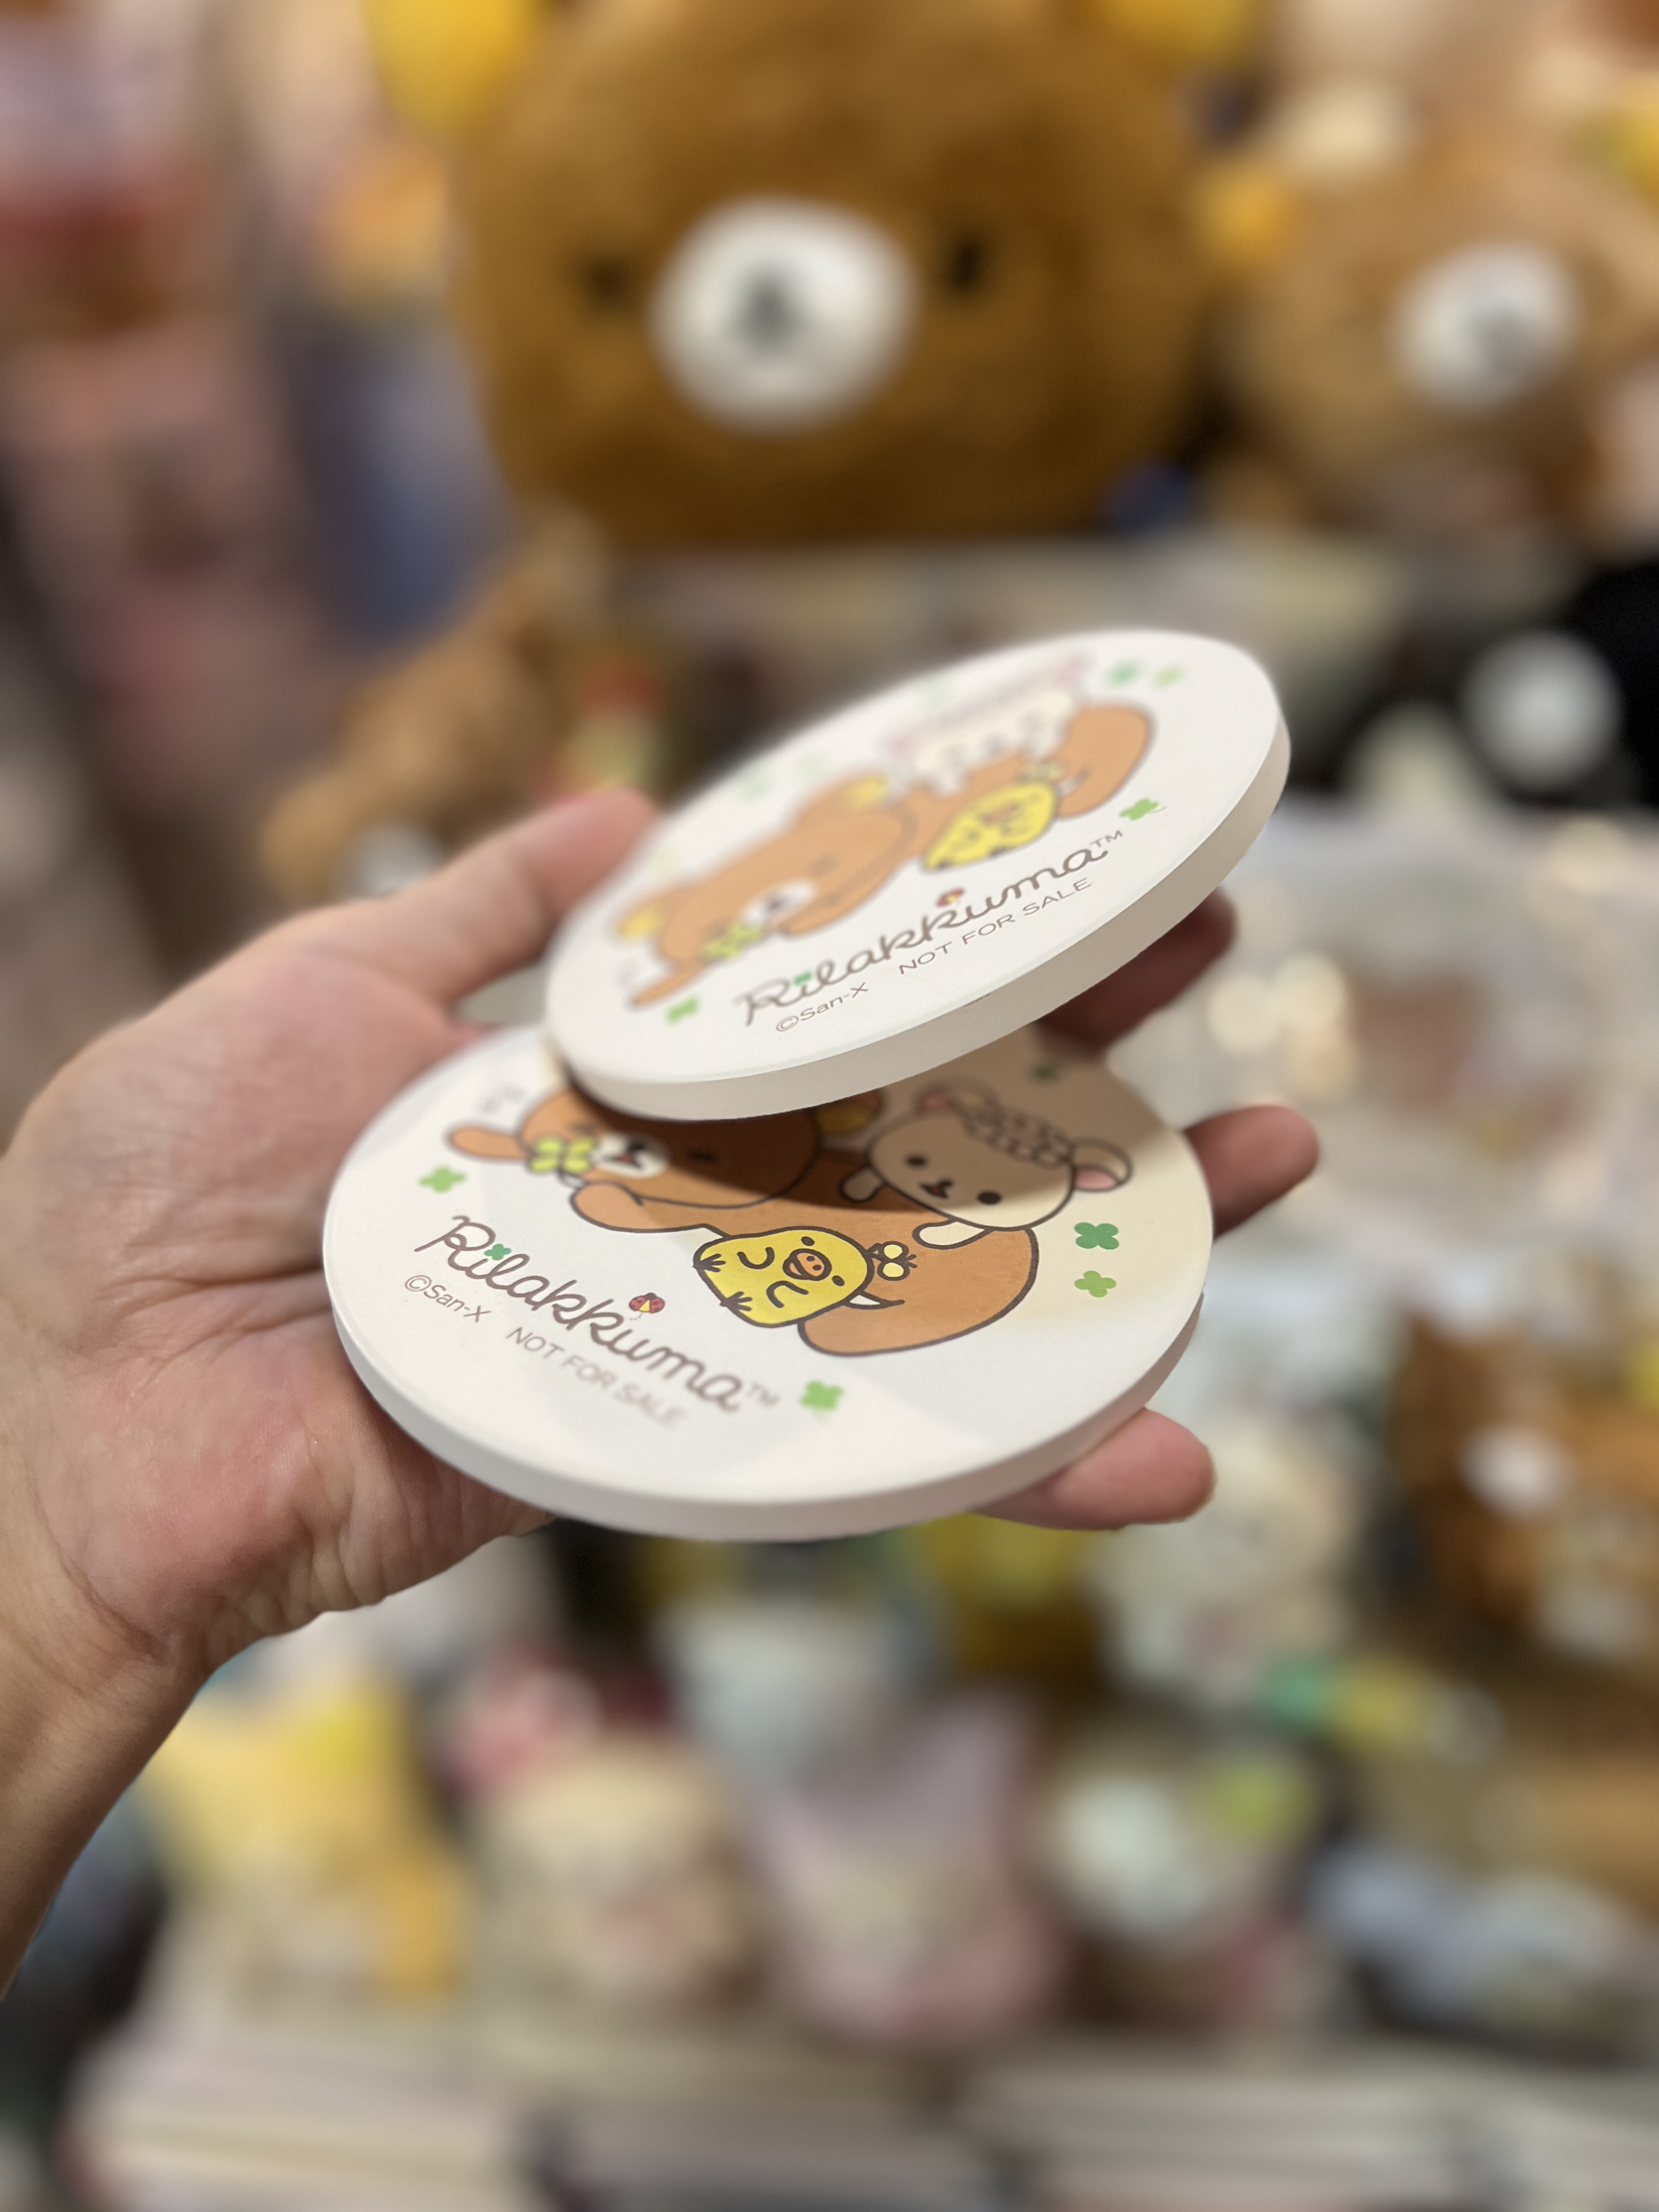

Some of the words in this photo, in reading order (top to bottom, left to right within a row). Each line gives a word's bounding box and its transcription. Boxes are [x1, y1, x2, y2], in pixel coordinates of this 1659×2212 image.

[898, 941, 952, 975] NOT
[961, 915, 1016, 945] FOR
[1023, 878, 1092, 916] SALE
[506, 1326, 565, 1360] NOT
[560, 1355, 619, 1392] FOR
[613, 1382, 687, 1425] SALE
